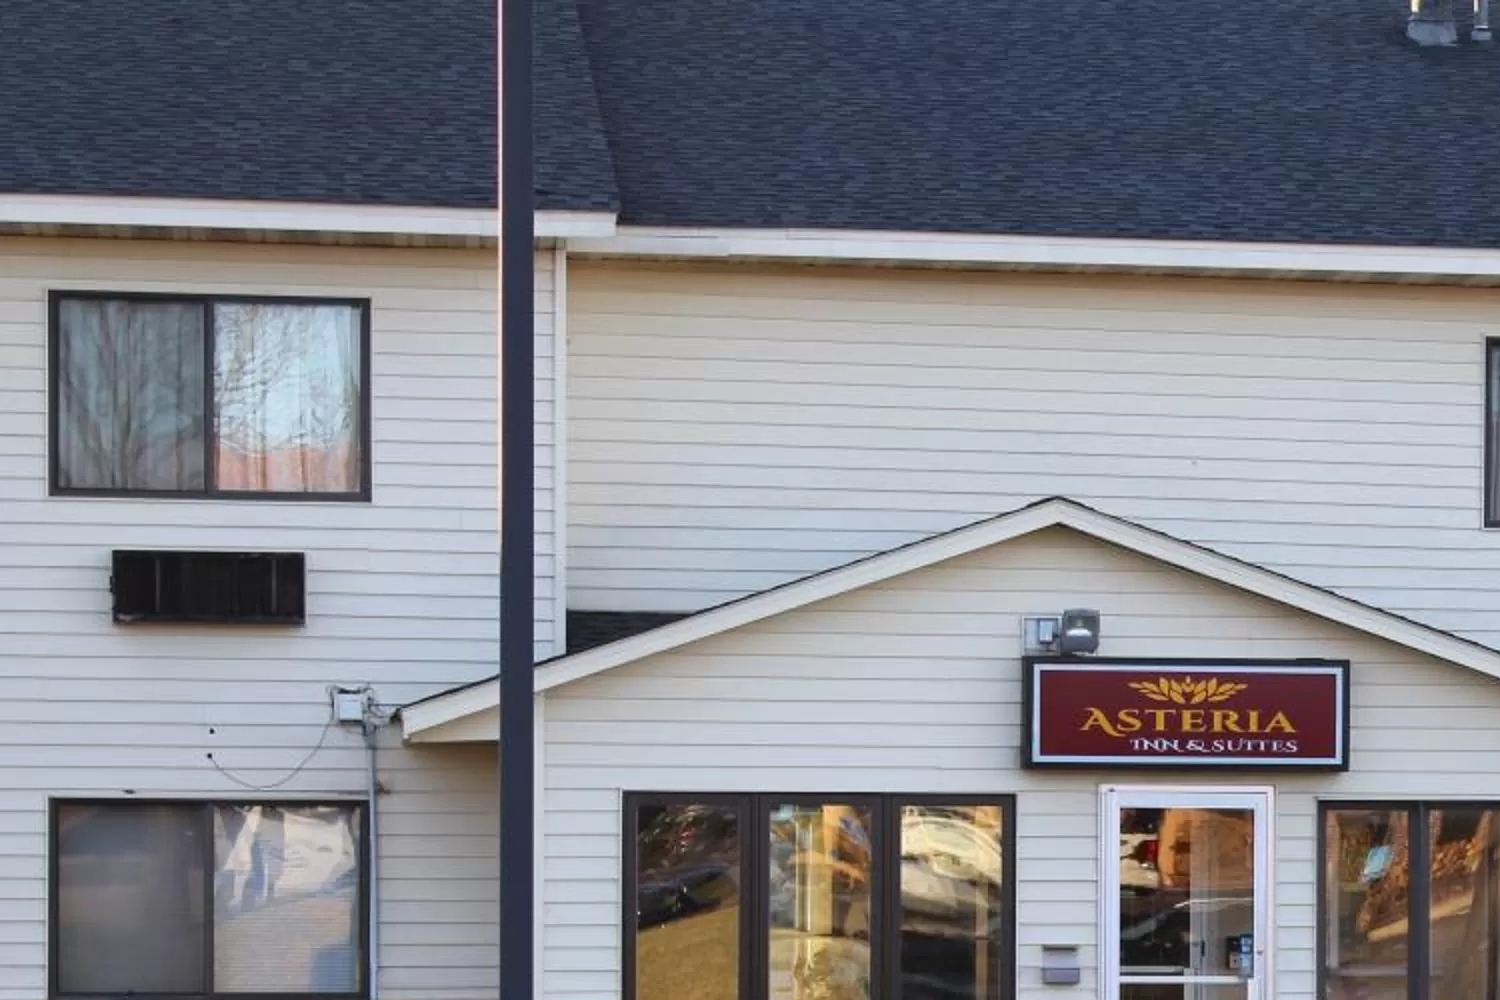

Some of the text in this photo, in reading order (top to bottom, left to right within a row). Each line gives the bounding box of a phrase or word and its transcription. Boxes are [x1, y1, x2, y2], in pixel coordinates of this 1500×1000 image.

[1080, 706, 1297, 737] ASTERIA
[1130, 738, 1299, 753] INN & SUITES
